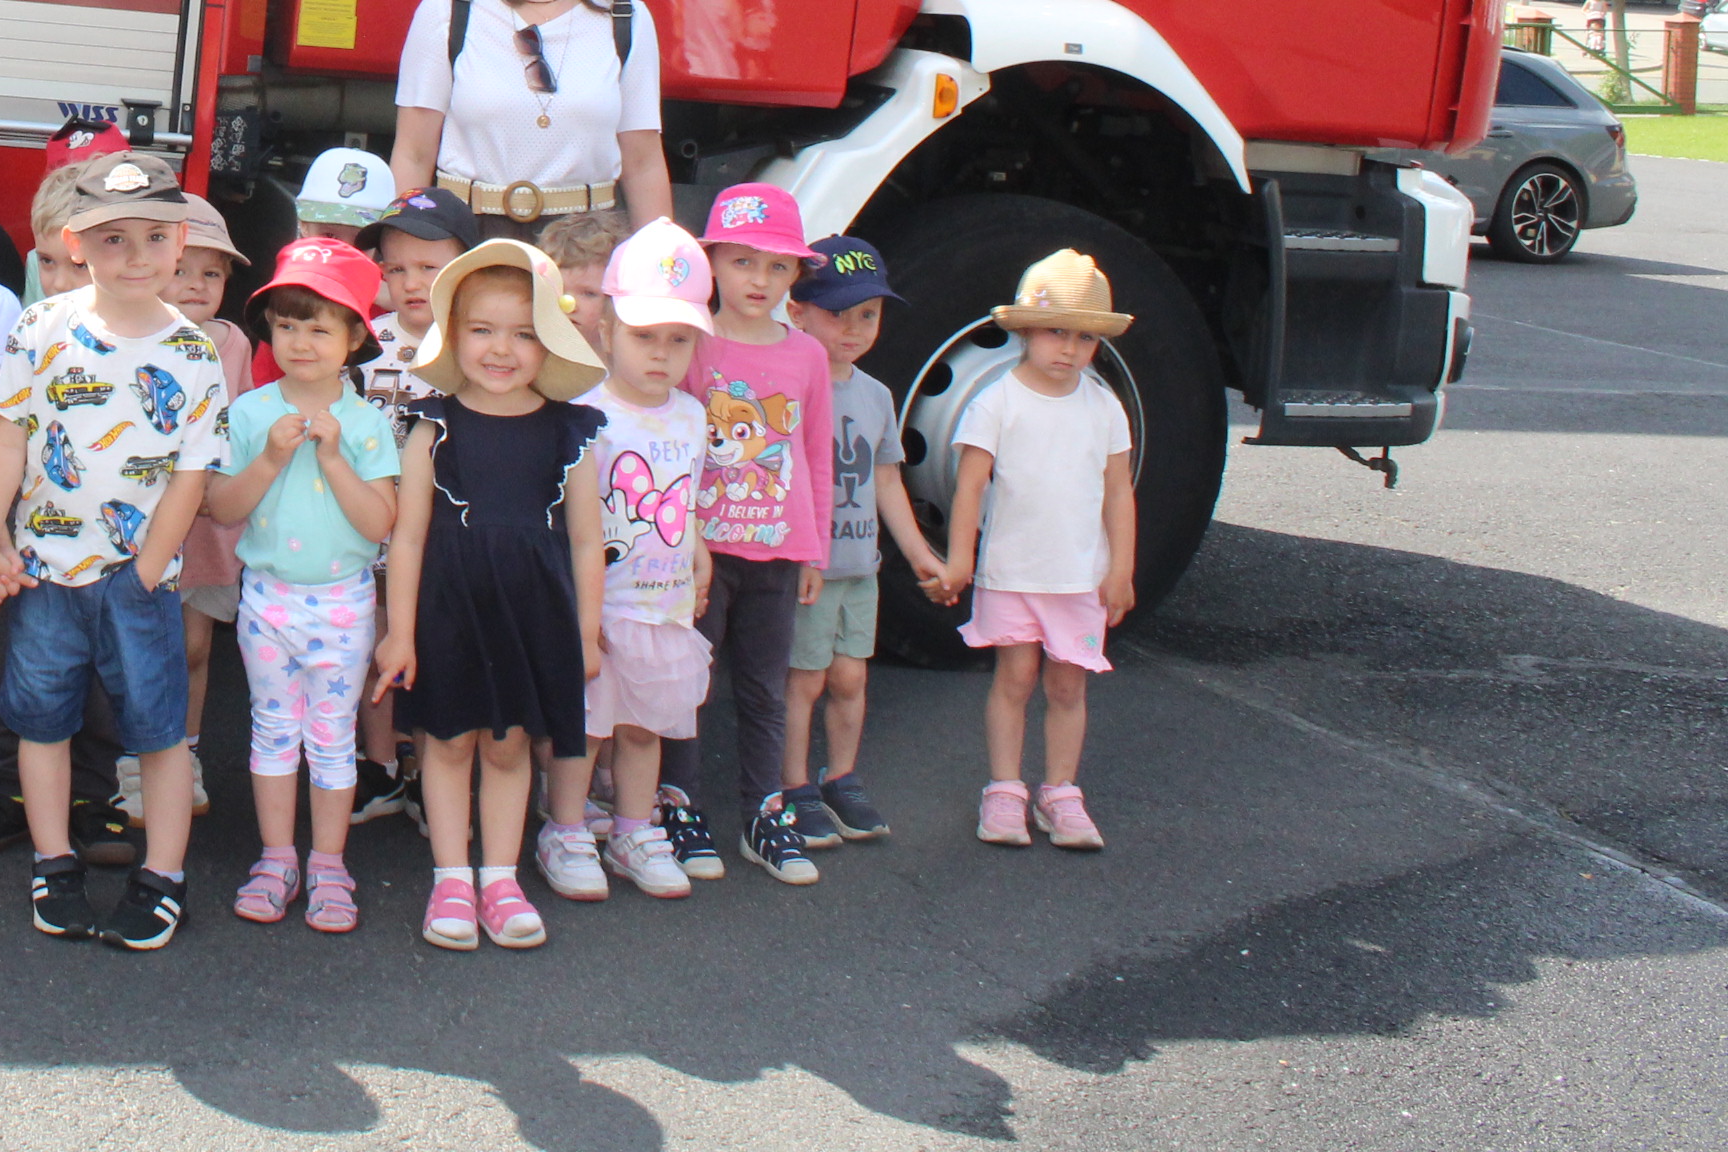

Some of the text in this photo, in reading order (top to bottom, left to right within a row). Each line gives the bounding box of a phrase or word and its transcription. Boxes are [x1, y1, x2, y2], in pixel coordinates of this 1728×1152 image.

[57, 102, 119, 123] WISS
[833, 250, 877, 276] NYC
[649, 439, 690, 463] BEST
[719, 504, 726, 516] I
[728, 505, 770, 519] BELIEVE
